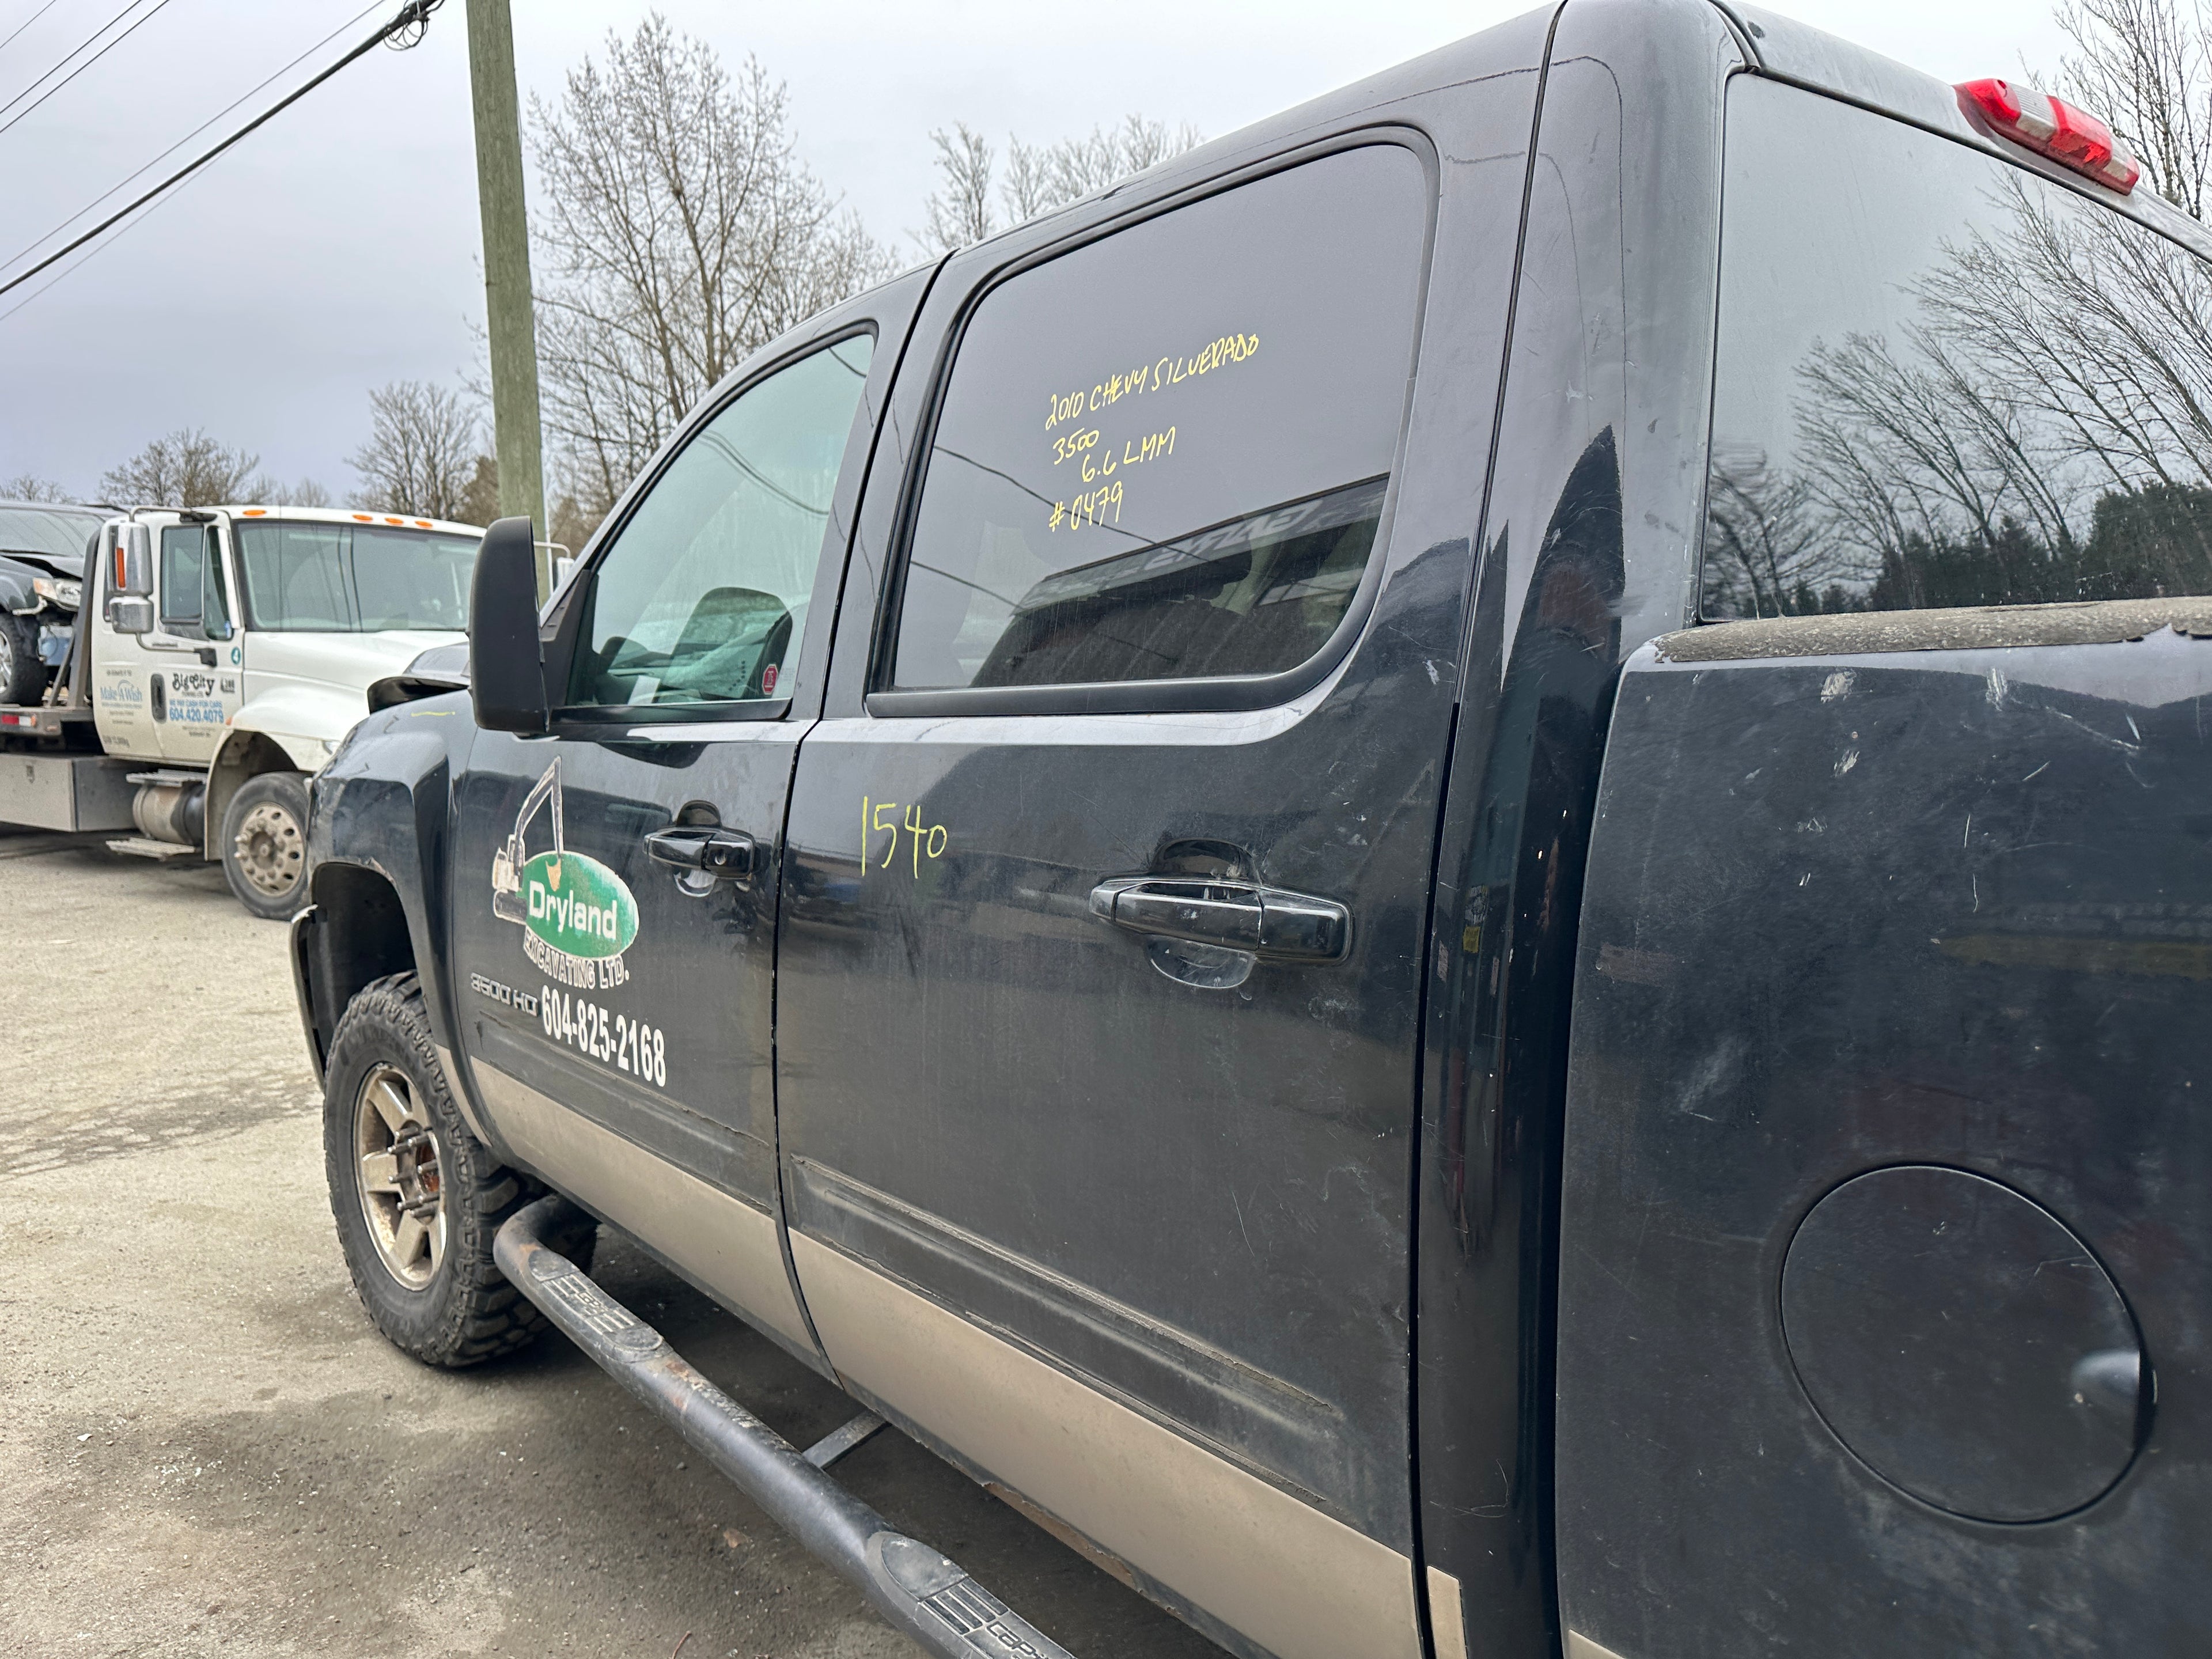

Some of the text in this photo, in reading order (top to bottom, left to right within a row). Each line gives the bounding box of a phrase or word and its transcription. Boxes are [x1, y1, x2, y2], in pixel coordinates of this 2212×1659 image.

[1045, 334, 1259, 430] 2010 CHEVY SILVERADO
[1052, 427, 1100, 465] 3500
[1081, 426, 1176, 483] 6.6 LMM
[1048, 481, 1123, 532] #0479
[169, 707, 224, 724] 604.420.4079
[861, 796, 948, 879] 1540
[529, 880, 618, 940] Dryland
[524, 927, 630, 990] EXCAVATING LTD.
[470, 972, 512, 1006] 3500
[541, 984, 666, 1088] 604-825-2168
